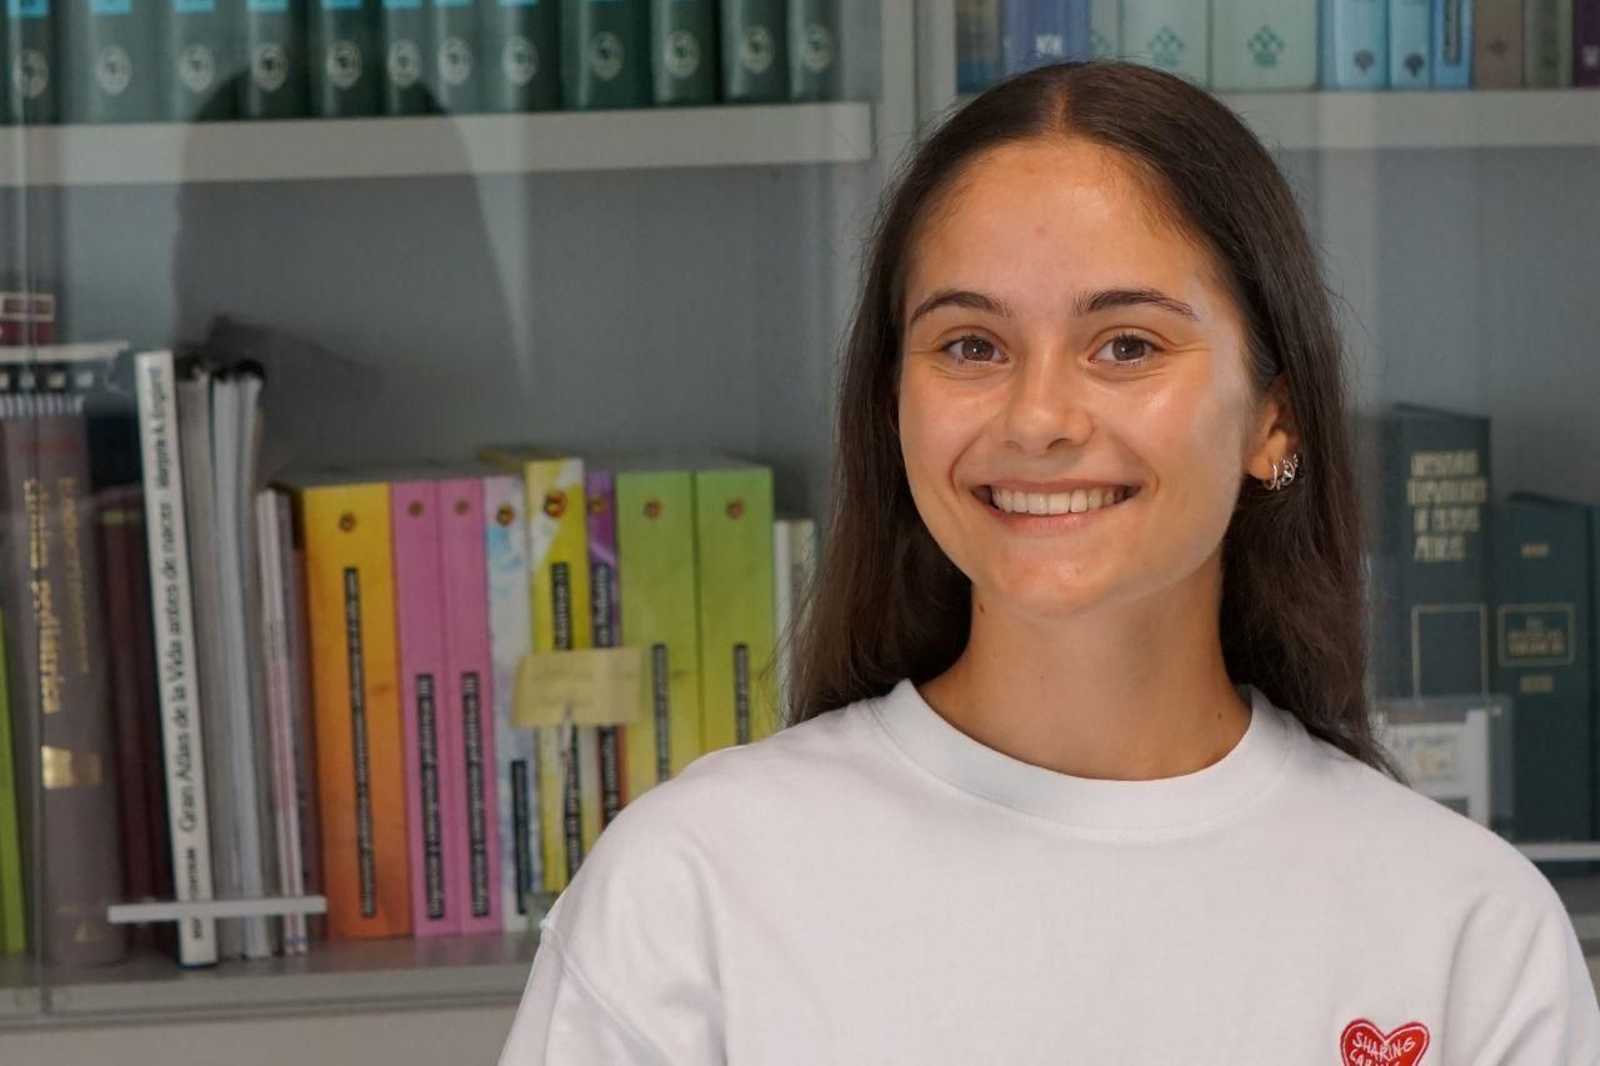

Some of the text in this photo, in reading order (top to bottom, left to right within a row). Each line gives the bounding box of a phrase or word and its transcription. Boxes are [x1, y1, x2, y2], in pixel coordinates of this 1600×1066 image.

[158, 502, 175, 555] nacer
[159, 557, 177, 582] de
[163, 583, 181, 637] antes
[164, 639, 184, 684] Vida
[167, 685, 187, 703] la
[172, 708, 189, 731] de
[173, 733, 194, 783] Atlas
[178, 784, 198, 833] Gran
[1352, 1032, 1416, 1061] SHARING
